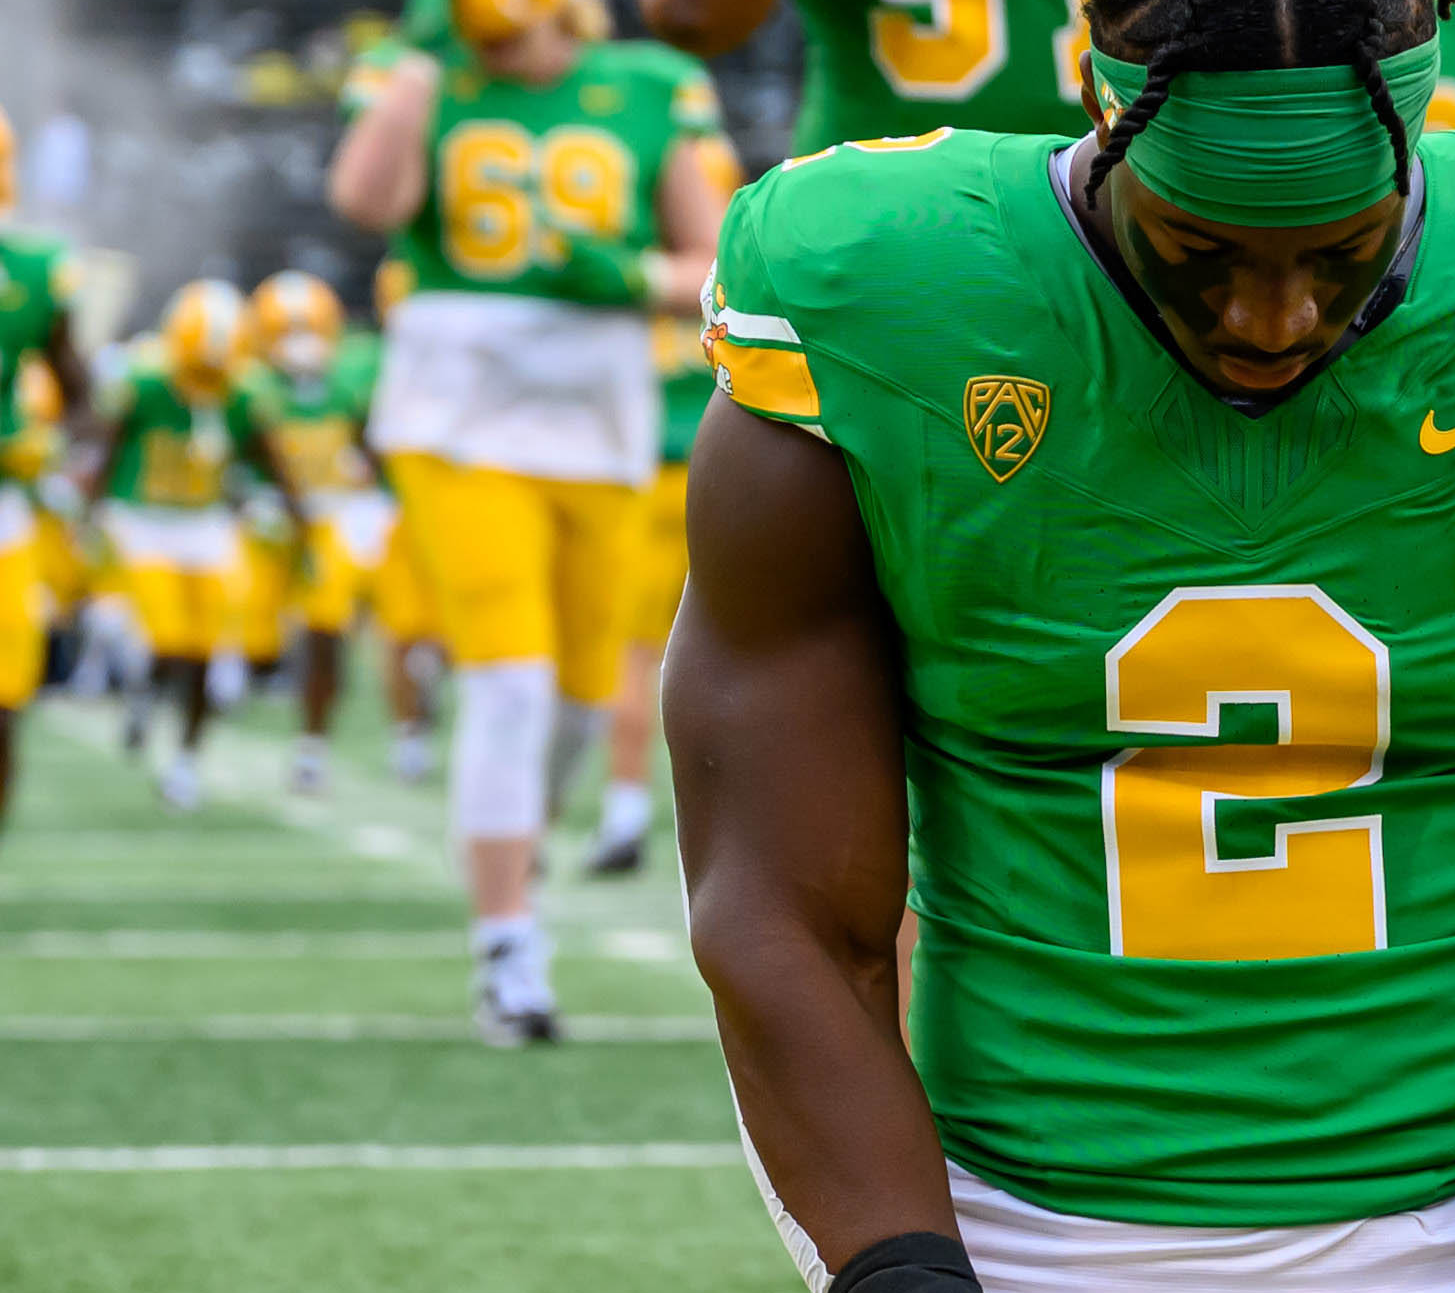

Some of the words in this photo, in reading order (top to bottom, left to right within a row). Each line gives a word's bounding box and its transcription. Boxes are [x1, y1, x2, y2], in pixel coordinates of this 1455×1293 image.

[439, 117, 636, 279] 69
[969, 380, 1044, 444] PAC
[984, 422, 1025, 461] 12
[1100, 582, 1391, 958] 2
